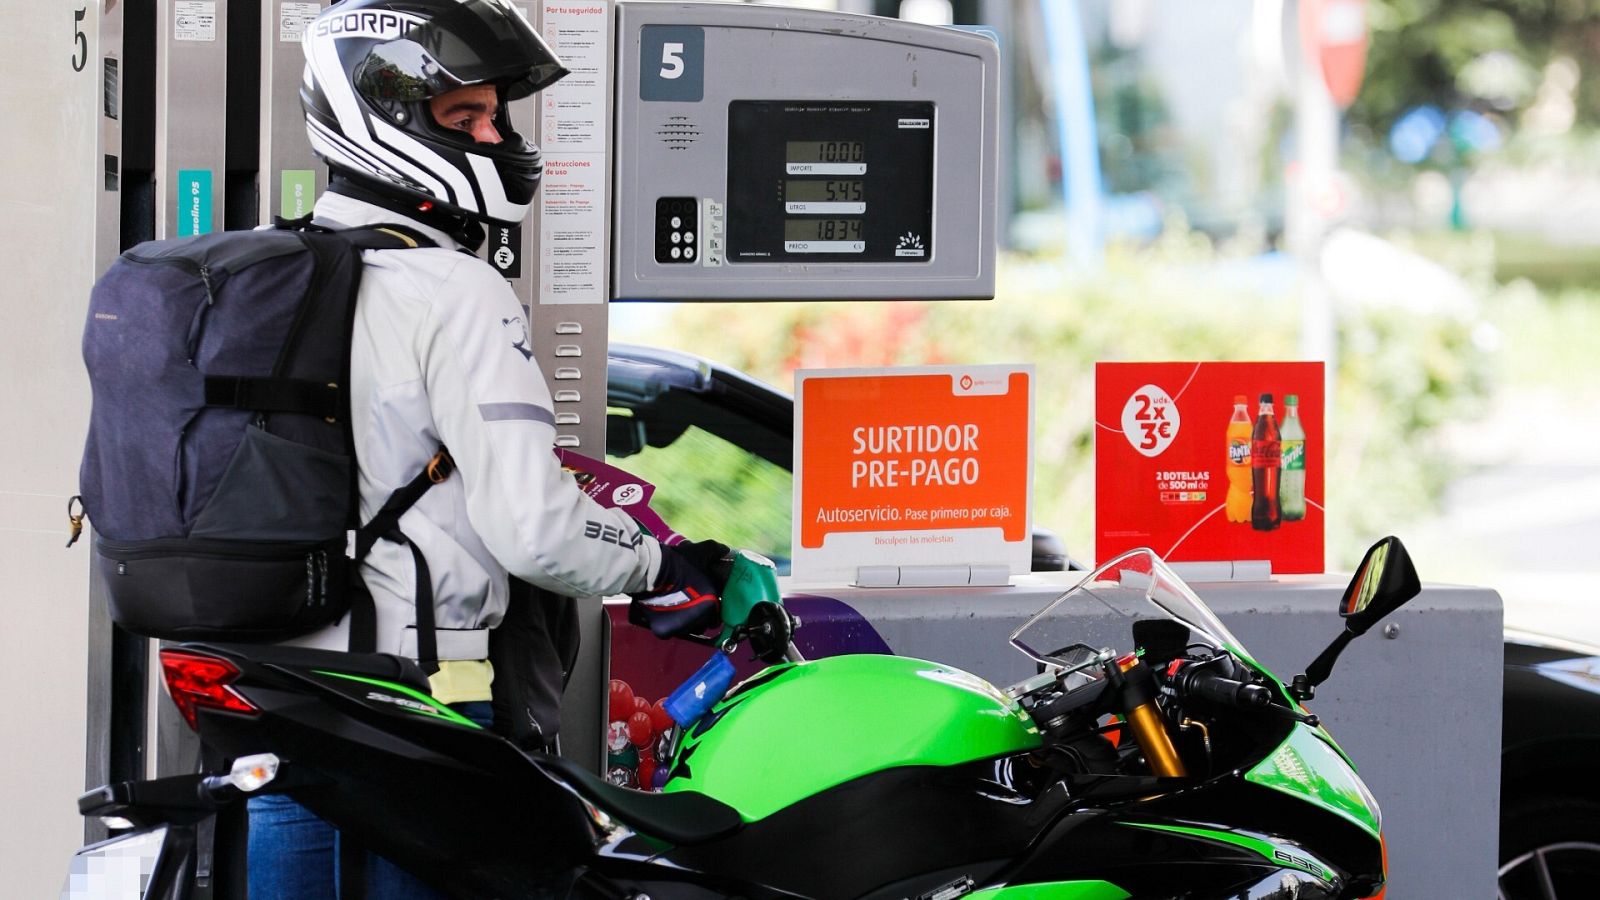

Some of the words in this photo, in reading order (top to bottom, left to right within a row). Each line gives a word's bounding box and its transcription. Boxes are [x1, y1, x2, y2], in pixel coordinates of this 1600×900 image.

[568, 7, 603, 15] seguridad
[72, 7, 88, 73] 5
[317, 13, 443, 57] SCORPION
[659, 43, 685, 80] 5
[819, 143, 863, 161] 10.00
[191, 181, 200, 196] 95
[295, 184, 303, 198] 98
[825, 181, 862, 201] 5.45
[191, 197, 200, 236] asolina
[295, 199, 303, 219] lina
[500, 228, 509, 245] Dié
[818, 220, 862, 240] 1.834
[499, 252, 508, 264] Hi
[1135, 394, 1151, 420] 2
[1153, 396, 1170, 404] uds.
[1153, 407, 1165, 420] x
[852, 423, 979, 455] SURTIDOR
[852, 457, 979, 488] PRE-PAGO
[1156, 471, 1162, 480] 2
[1163, 471, 1210, 480] BOTELLAS
[1158, 481, 1169, 490] de
[1169, 481, 1186, 490] 500
[1187, 481, 1198, 489] ml
[1198, 481, 1209, 490] de
[816, 505, 902, 523] Autoservicio.
[905, 508, 927, 520] Pase
[930, 507, 968, 524] primero
[971, 507, 987, 523] por
[990, 505, 1012, 520] caja.
[874, 536, 908, 546] Disculpen
[909, 536, 919, 544] las
[920, 535, 954, 544] molestias
[1274, 850, 1324, 877] 636
